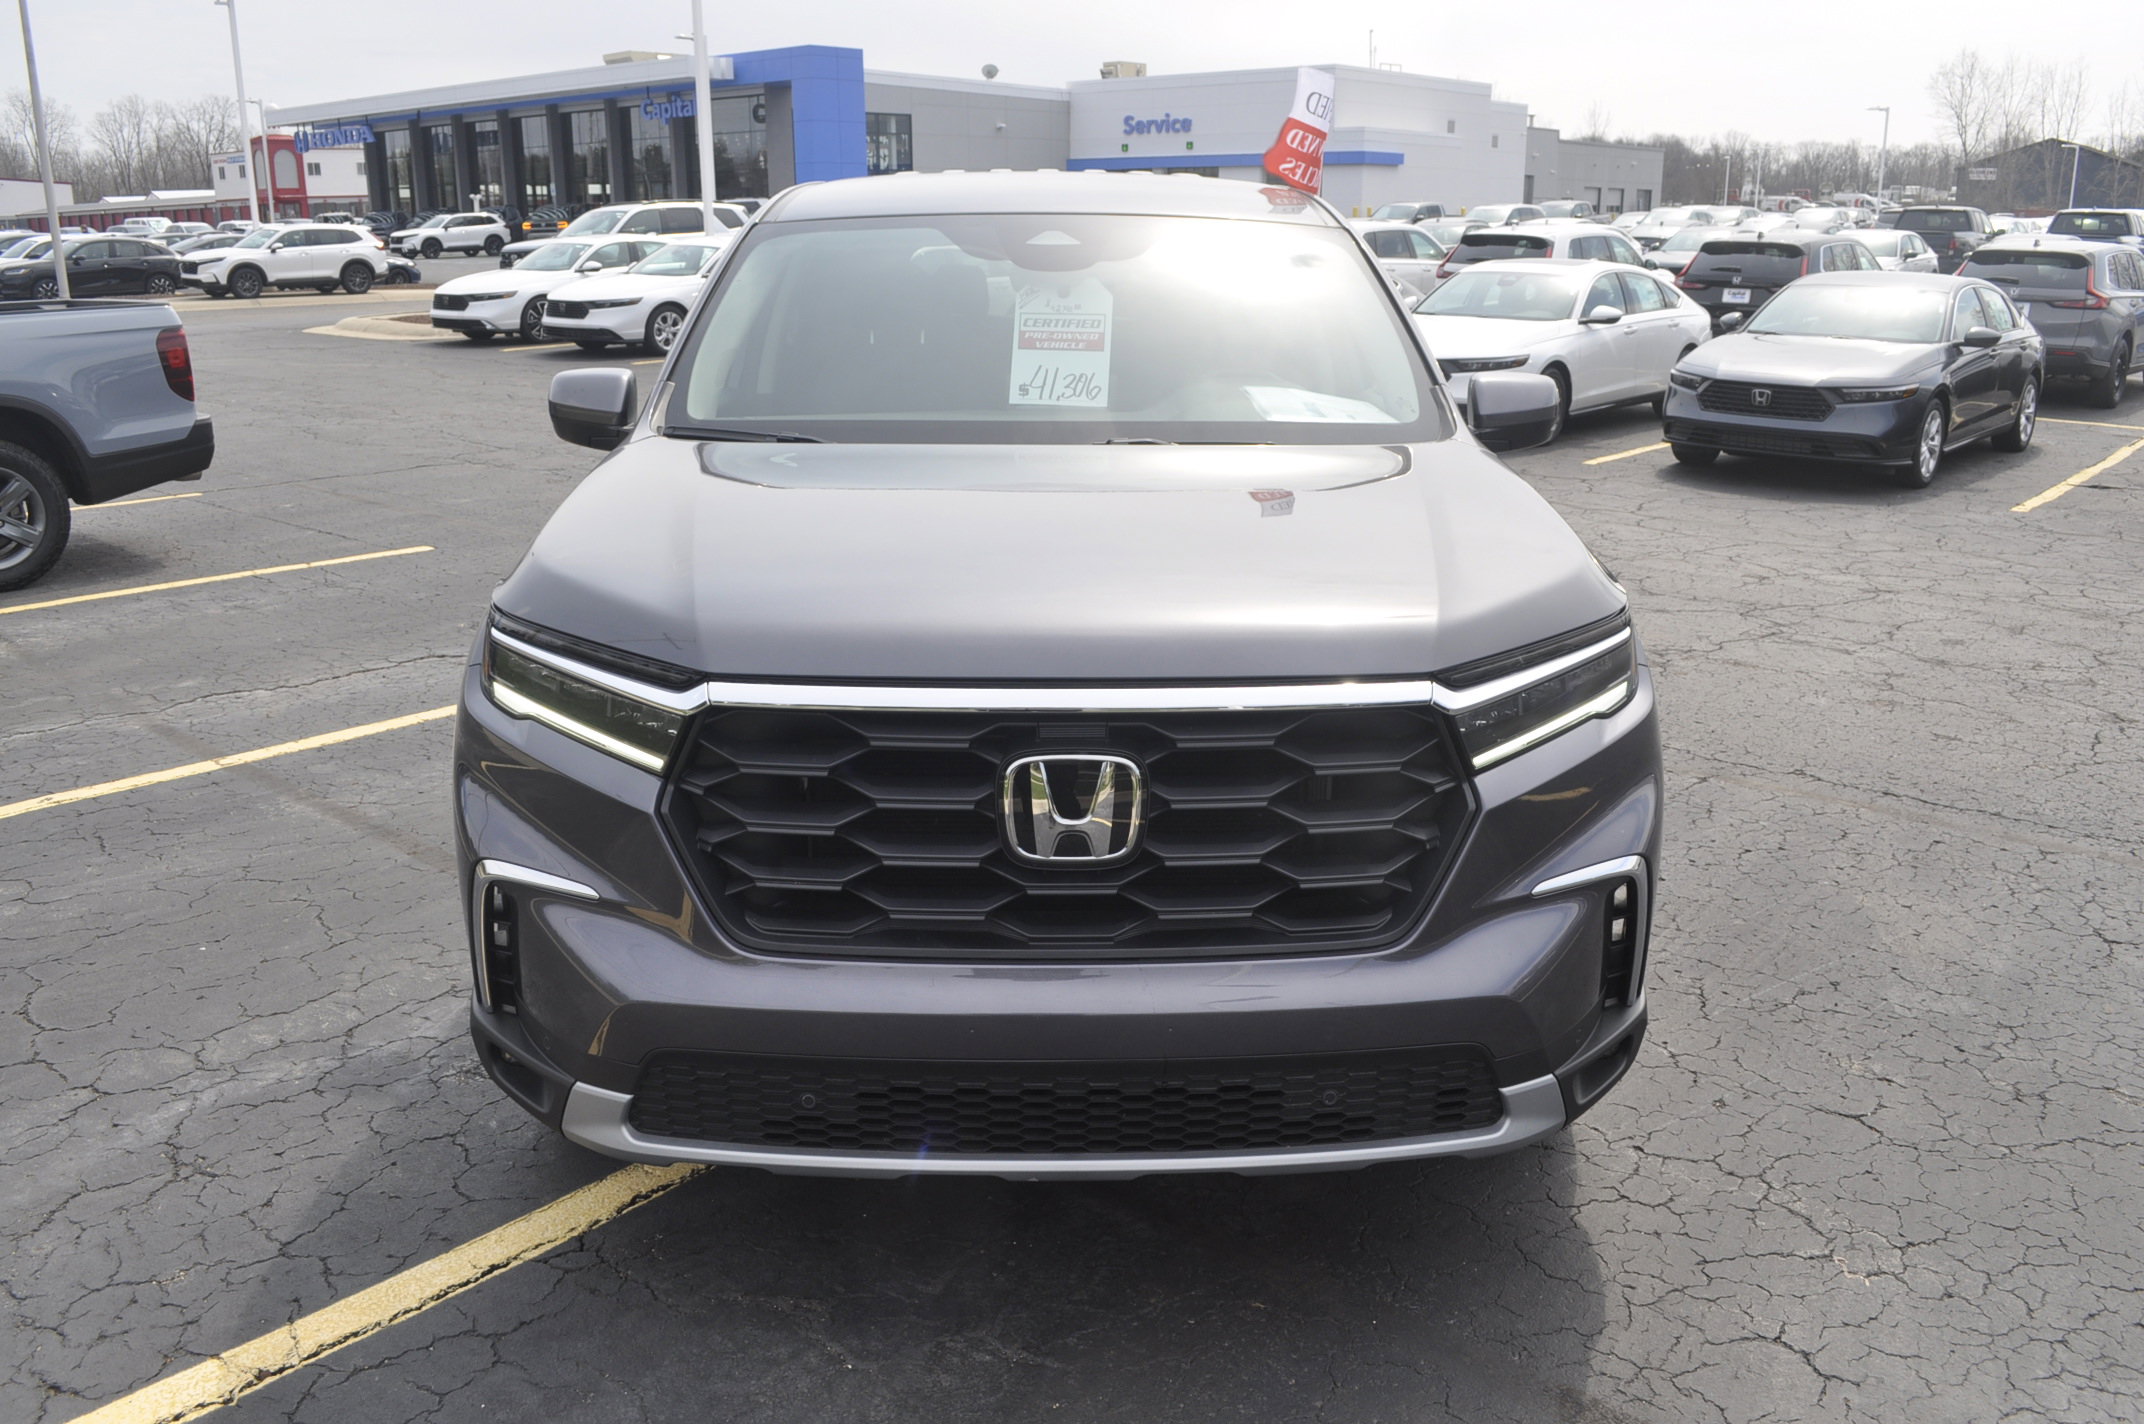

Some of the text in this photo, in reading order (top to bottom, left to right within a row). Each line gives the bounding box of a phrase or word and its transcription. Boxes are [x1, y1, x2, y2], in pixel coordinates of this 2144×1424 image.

[1123, 112, 1192, 135] Service
[309, 125, 376, 148] HONDA
[1023, 318, 1101, 328] CERTIFIED
[1024, 332, 1099, 340] PRE-OWNED
[1035, 341, 1087, 349] VEHICLE
[1018, 365, 1102, 401] $41,306
